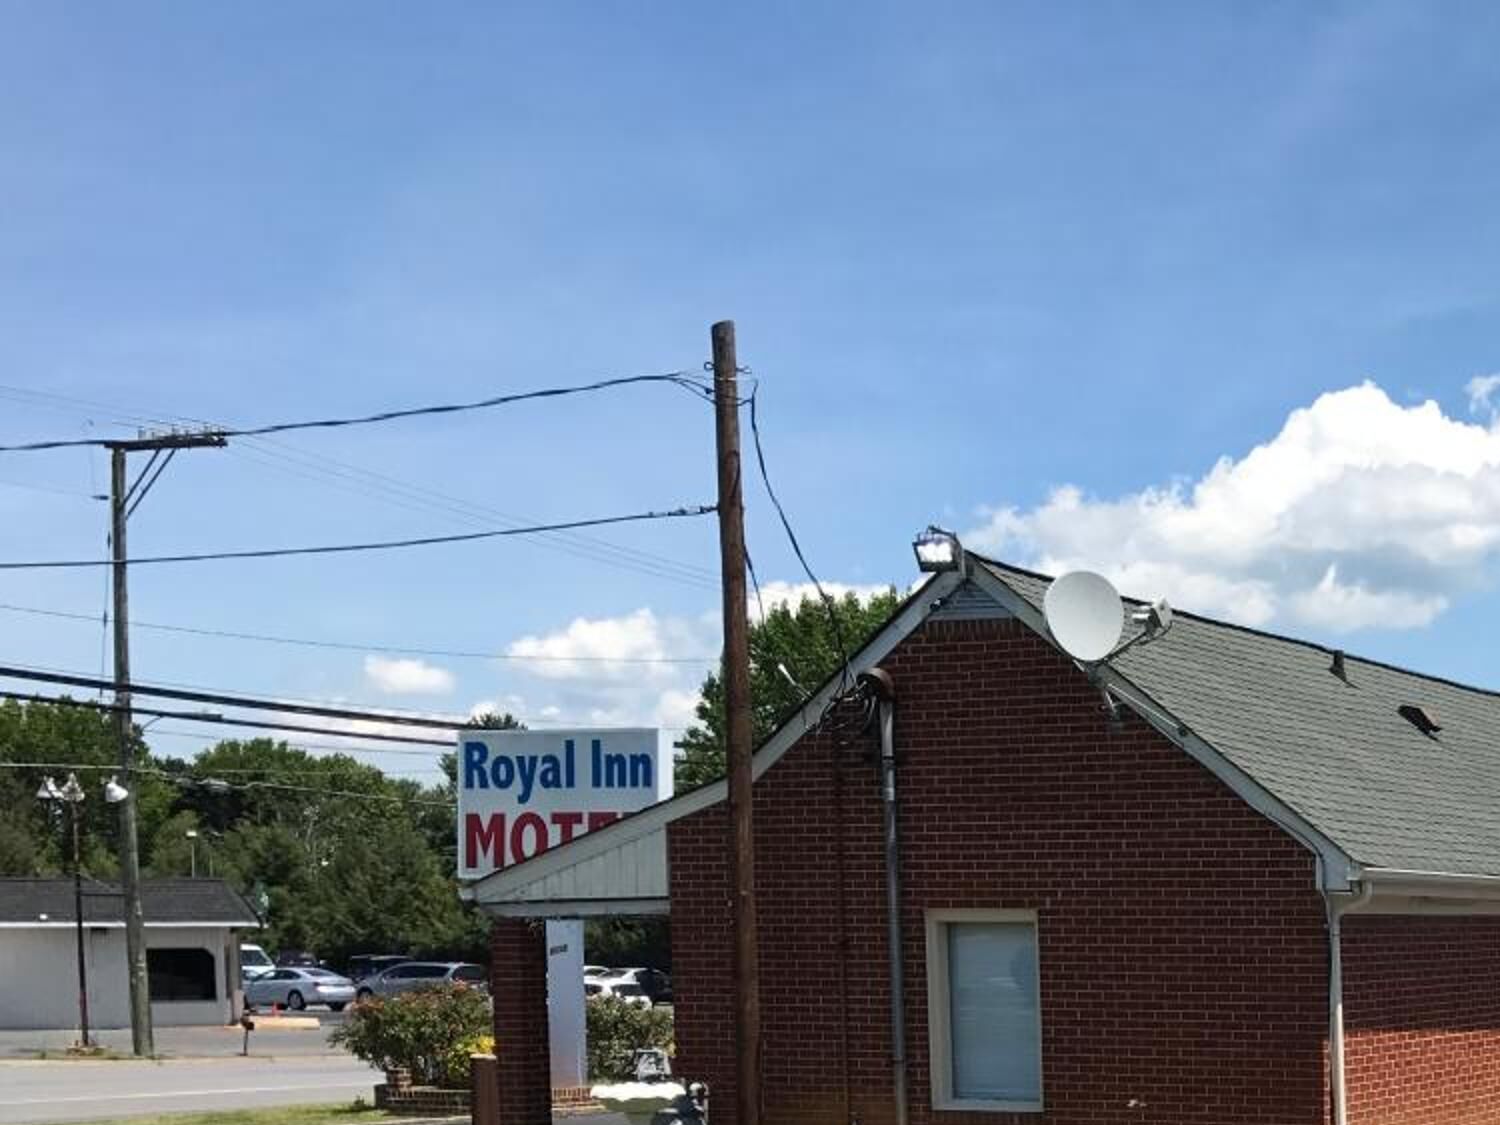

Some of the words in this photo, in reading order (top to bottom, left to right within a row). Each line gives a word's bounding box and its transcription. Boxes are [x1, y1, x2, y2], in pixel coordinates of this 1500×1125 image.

[464, 739, 575, 804] Royal
[591, 739, 653, 789] Inn
[465, 811, 639, 869] MOT
